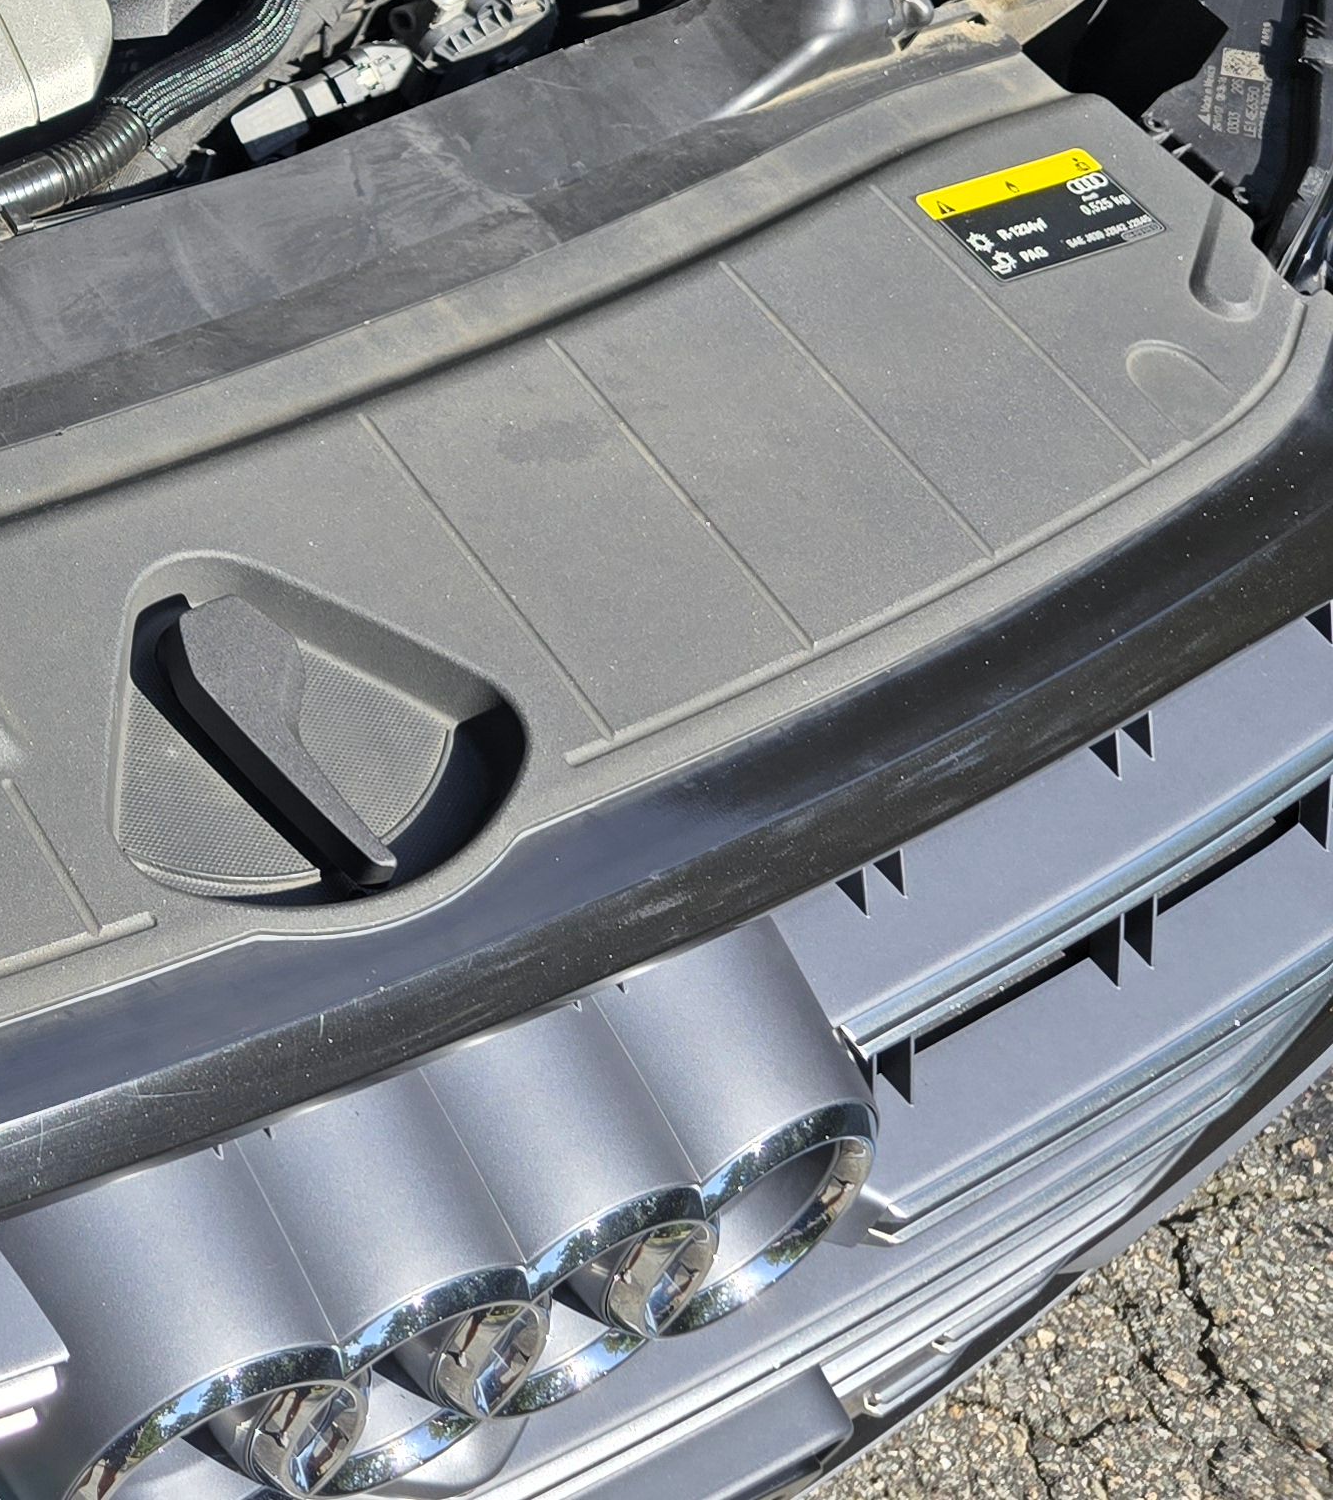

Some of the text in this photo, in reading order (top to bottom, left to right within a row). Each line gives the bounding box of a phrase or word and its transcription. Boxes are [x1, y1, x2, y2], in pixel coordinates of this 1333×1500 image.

[1079, 192, 1131, 217] 0,525 kg
[1019, 246, 1049, 263] PAG
